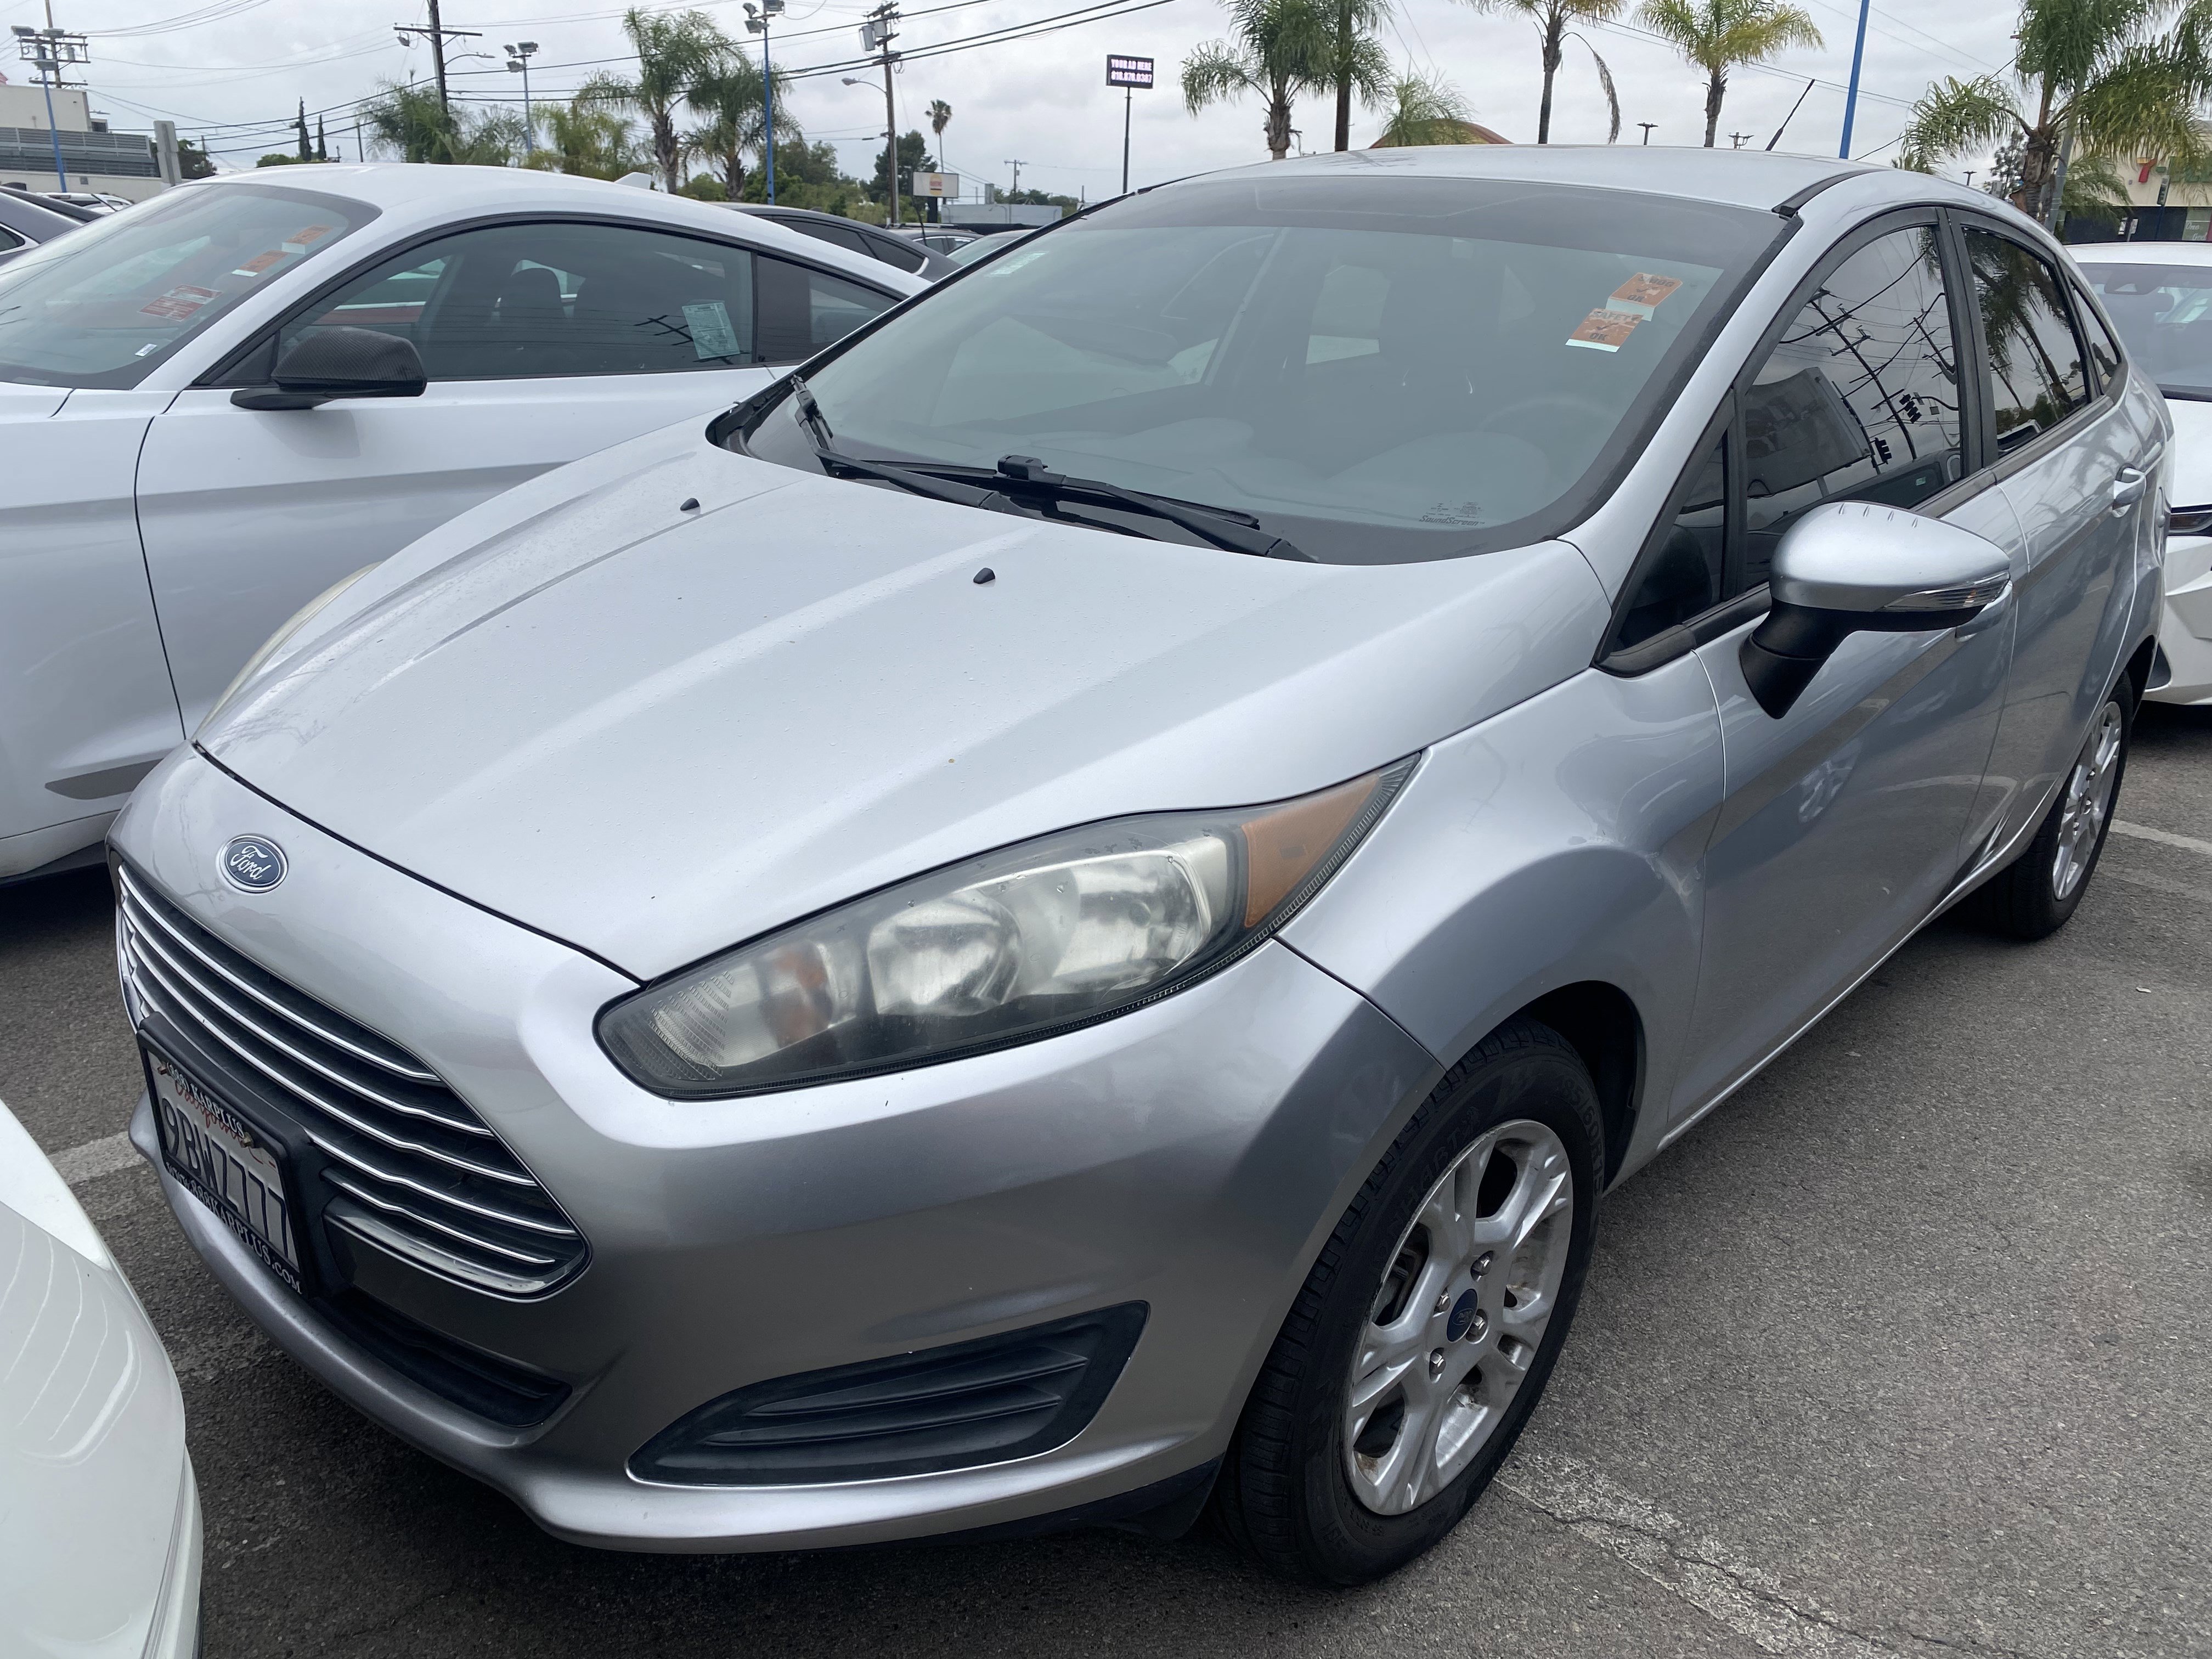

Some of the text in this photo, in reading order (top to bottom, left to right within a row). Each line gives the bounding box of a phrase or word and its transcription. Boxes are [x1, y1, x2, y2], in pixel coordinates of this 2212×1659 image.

[1589, 332, 1608, 341] OK
[1419, 515, 1480, 526] SoundScreen
[230, 845, 272, 880] Ford
[190, 1083, 245, 1139] KARPLUS
[162, 1098, 289, 1260] 9BWZ777
